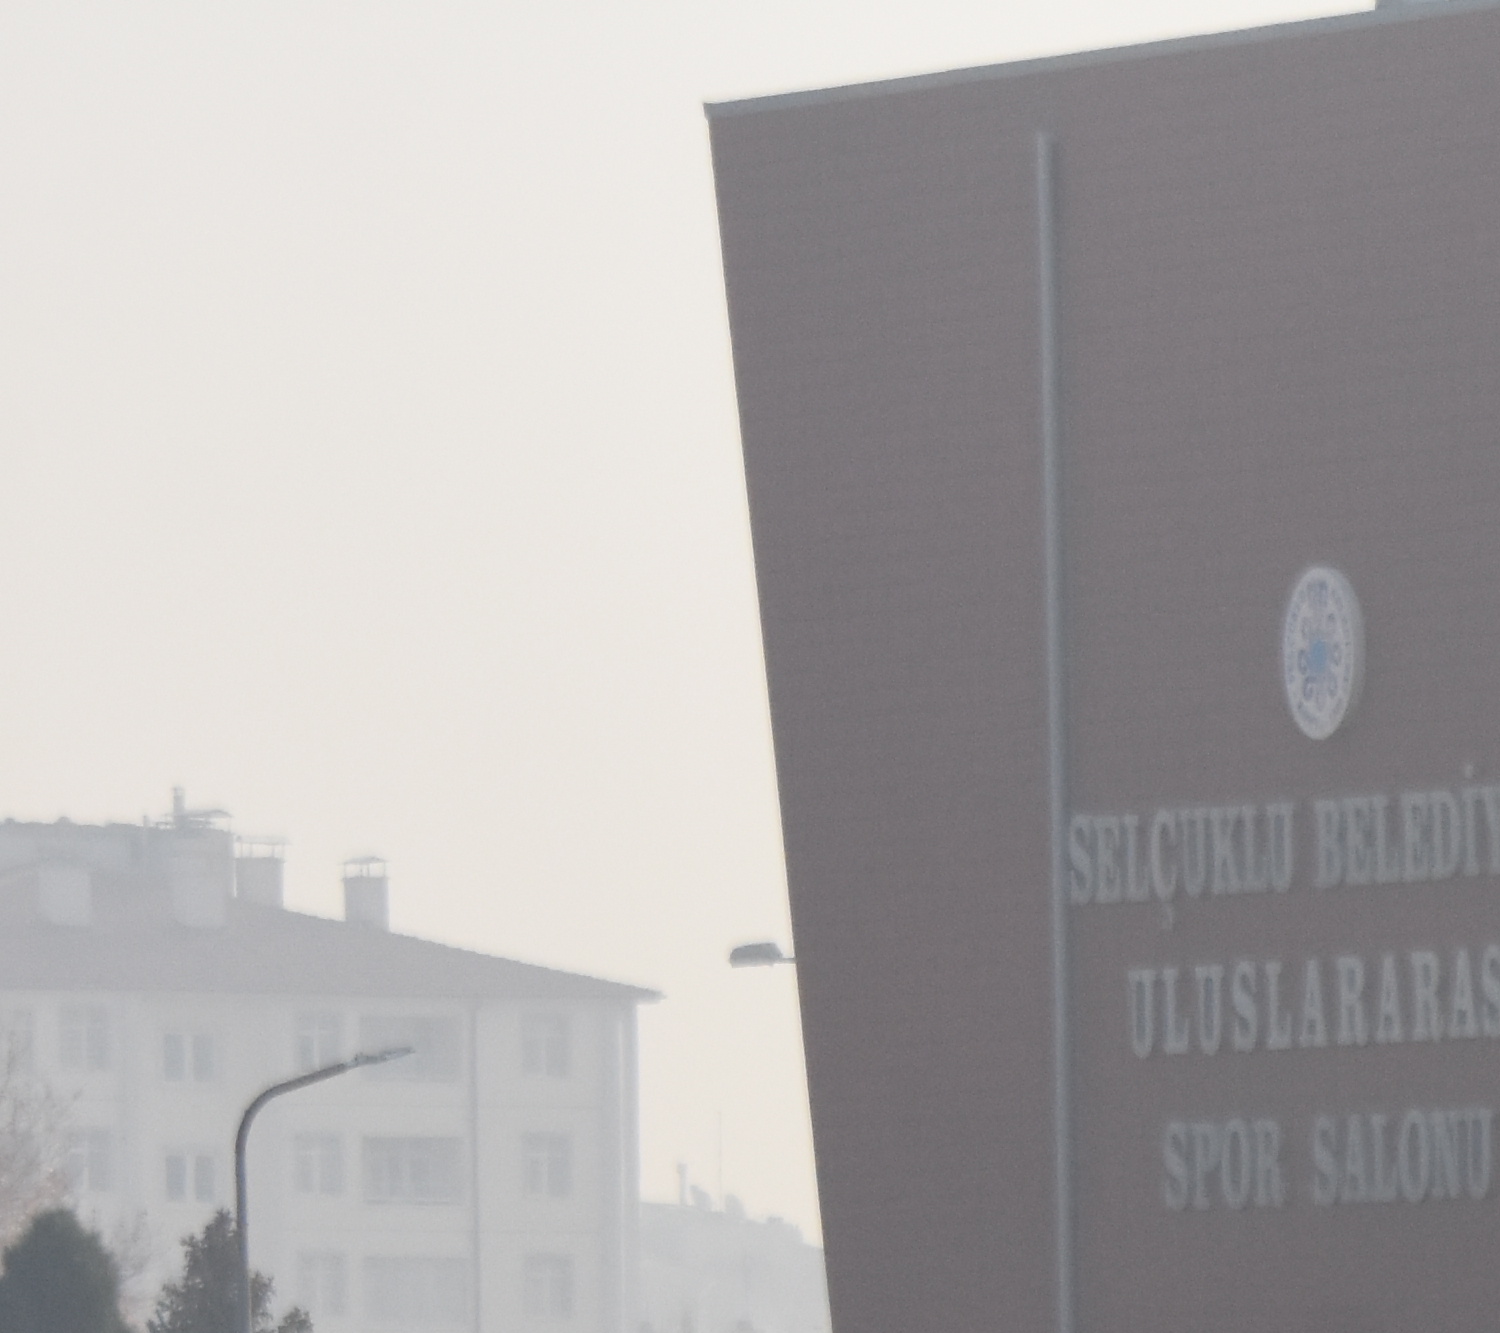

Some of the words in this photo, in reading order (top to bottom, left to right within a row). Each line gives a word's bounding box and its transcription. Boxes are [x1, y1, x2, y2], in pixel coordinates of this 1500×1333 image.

[1069, 804, 1294, 930] SELÇUKLU
[1163, 1117, 1285, 1210] SPOR
[1311, 1107, 1494, 1203] SALONU
